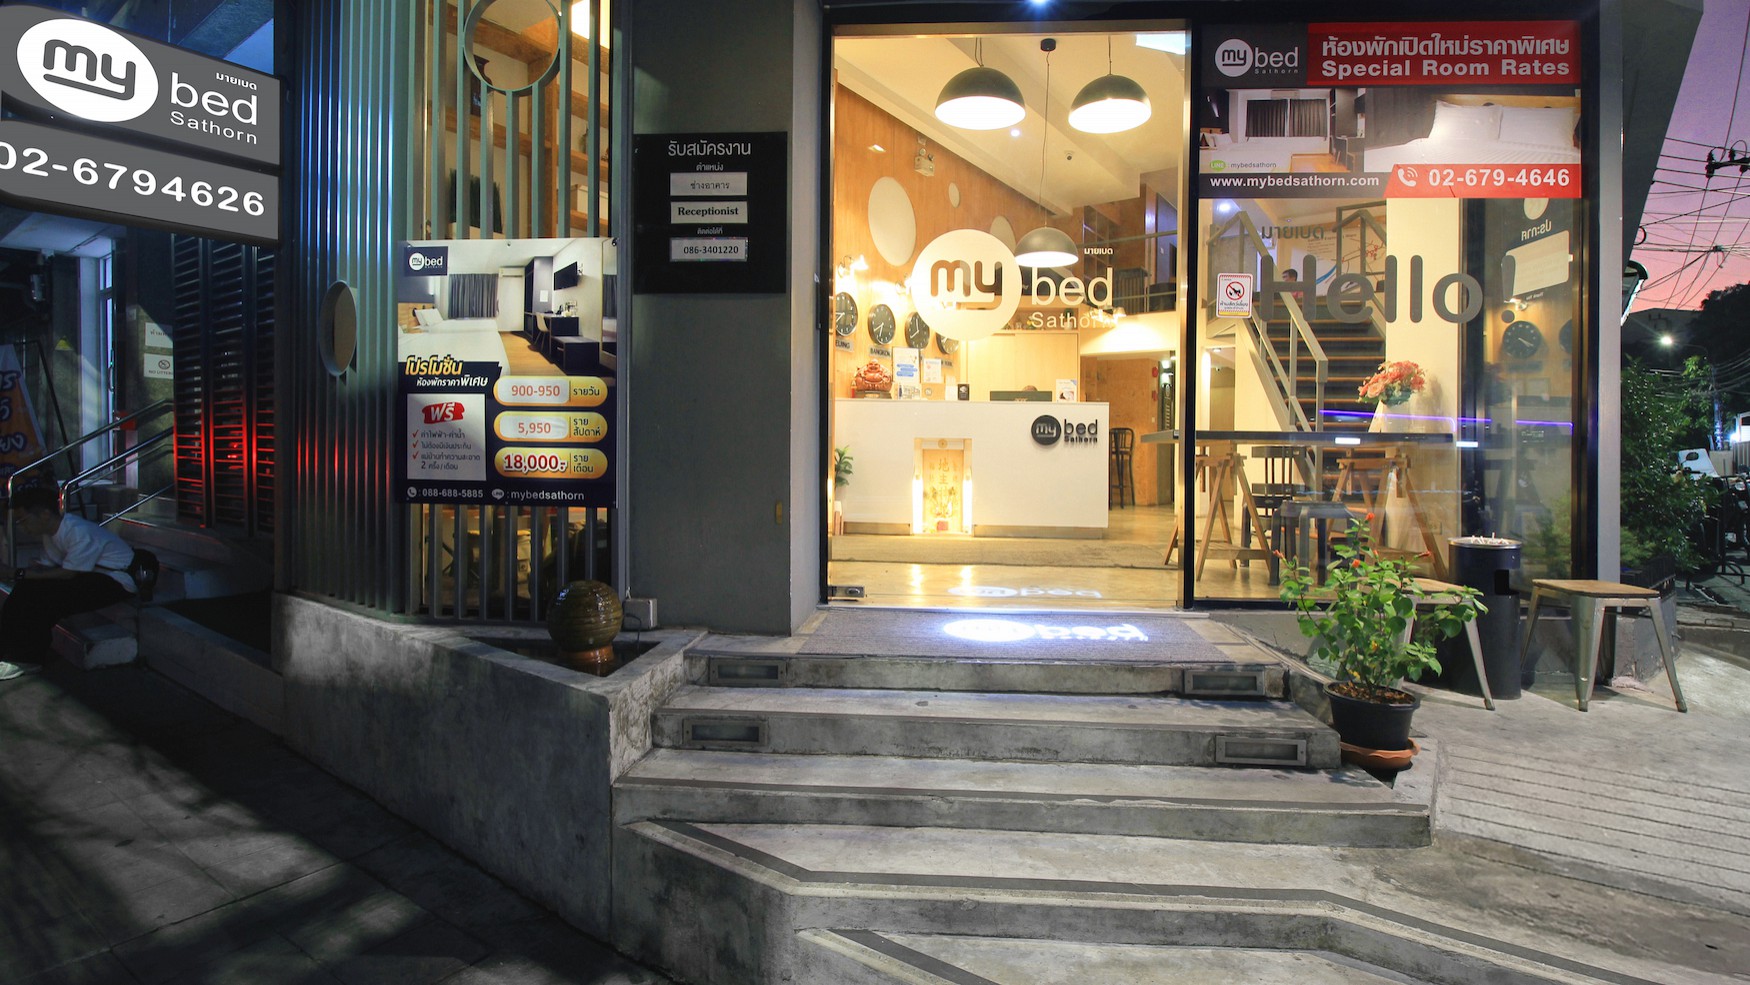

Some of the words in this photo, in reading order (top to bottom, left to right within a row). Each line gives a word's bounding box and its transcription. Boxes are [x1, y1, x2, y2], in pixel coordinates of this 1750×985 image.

[1321, 33, 1570, 58] ห้องพักเปิดใหม่ราคาพิเศษ
[1221, 48, 1246, 67] my
[1254, 47, 1299, 68] bed
[43, 39, 136, 101] my
[1321, 60, 1411, 78] Special
[1421, 60, 1490, 76] Room
[1500, 60, 1570, 76] Rates
[215, 72, 257, 91] มายเบด
[170, 71, 257, 126] bed
[170, 111, 257, 145] Sathorn
[668, 140, 752, 157] รับสมัครงาน
[1230, 162, 1277, 170] mybedsathorn
[0, 141, 265, 217] 02-6794626
[690, 180, 731, 190] ช่างอาคาร
[1210, 174, 1380, 190] www.mybedsathorn.com
[1428, 169, 1570, 187] 02-679-4646
[677, 206, 740, 217] Receptionist
[1261, 226, 1325, 241] มายเบด
[683, 245, 739, 255] 086-3401220
[1083, 246, 1114, 256] มายเบด
[425, 256, 443, 266] bed
[930, 259, 1004, 311] my
[1031, 266, 1113, 307] bed
[405, 354, 464, 376] โปรโมชั่น
[416, 374, 489, 387] ห้องพักราคาพิเศษ
[511, 384, 560, 397] 900-950
[573, 386, 600, 396] รายวัน
[430, 402, 455, 422] ฟรี
[518, 422, 552, 437] 5,950
[573, 418, 589, 426] ราย
[1064, 418, 1098, 435] bed
[573, 426, 601, 437] สัปดาห์
[1036, 423, 1057, 438] my
[421, 461, 426, 469] 2
[573, 454, 589, 463] ราย
[573, 463, 594, 473] เดือน
[422, 488, 484, 498] 088-688-5885
[511, 490, 585, 501] mybedsathorn
